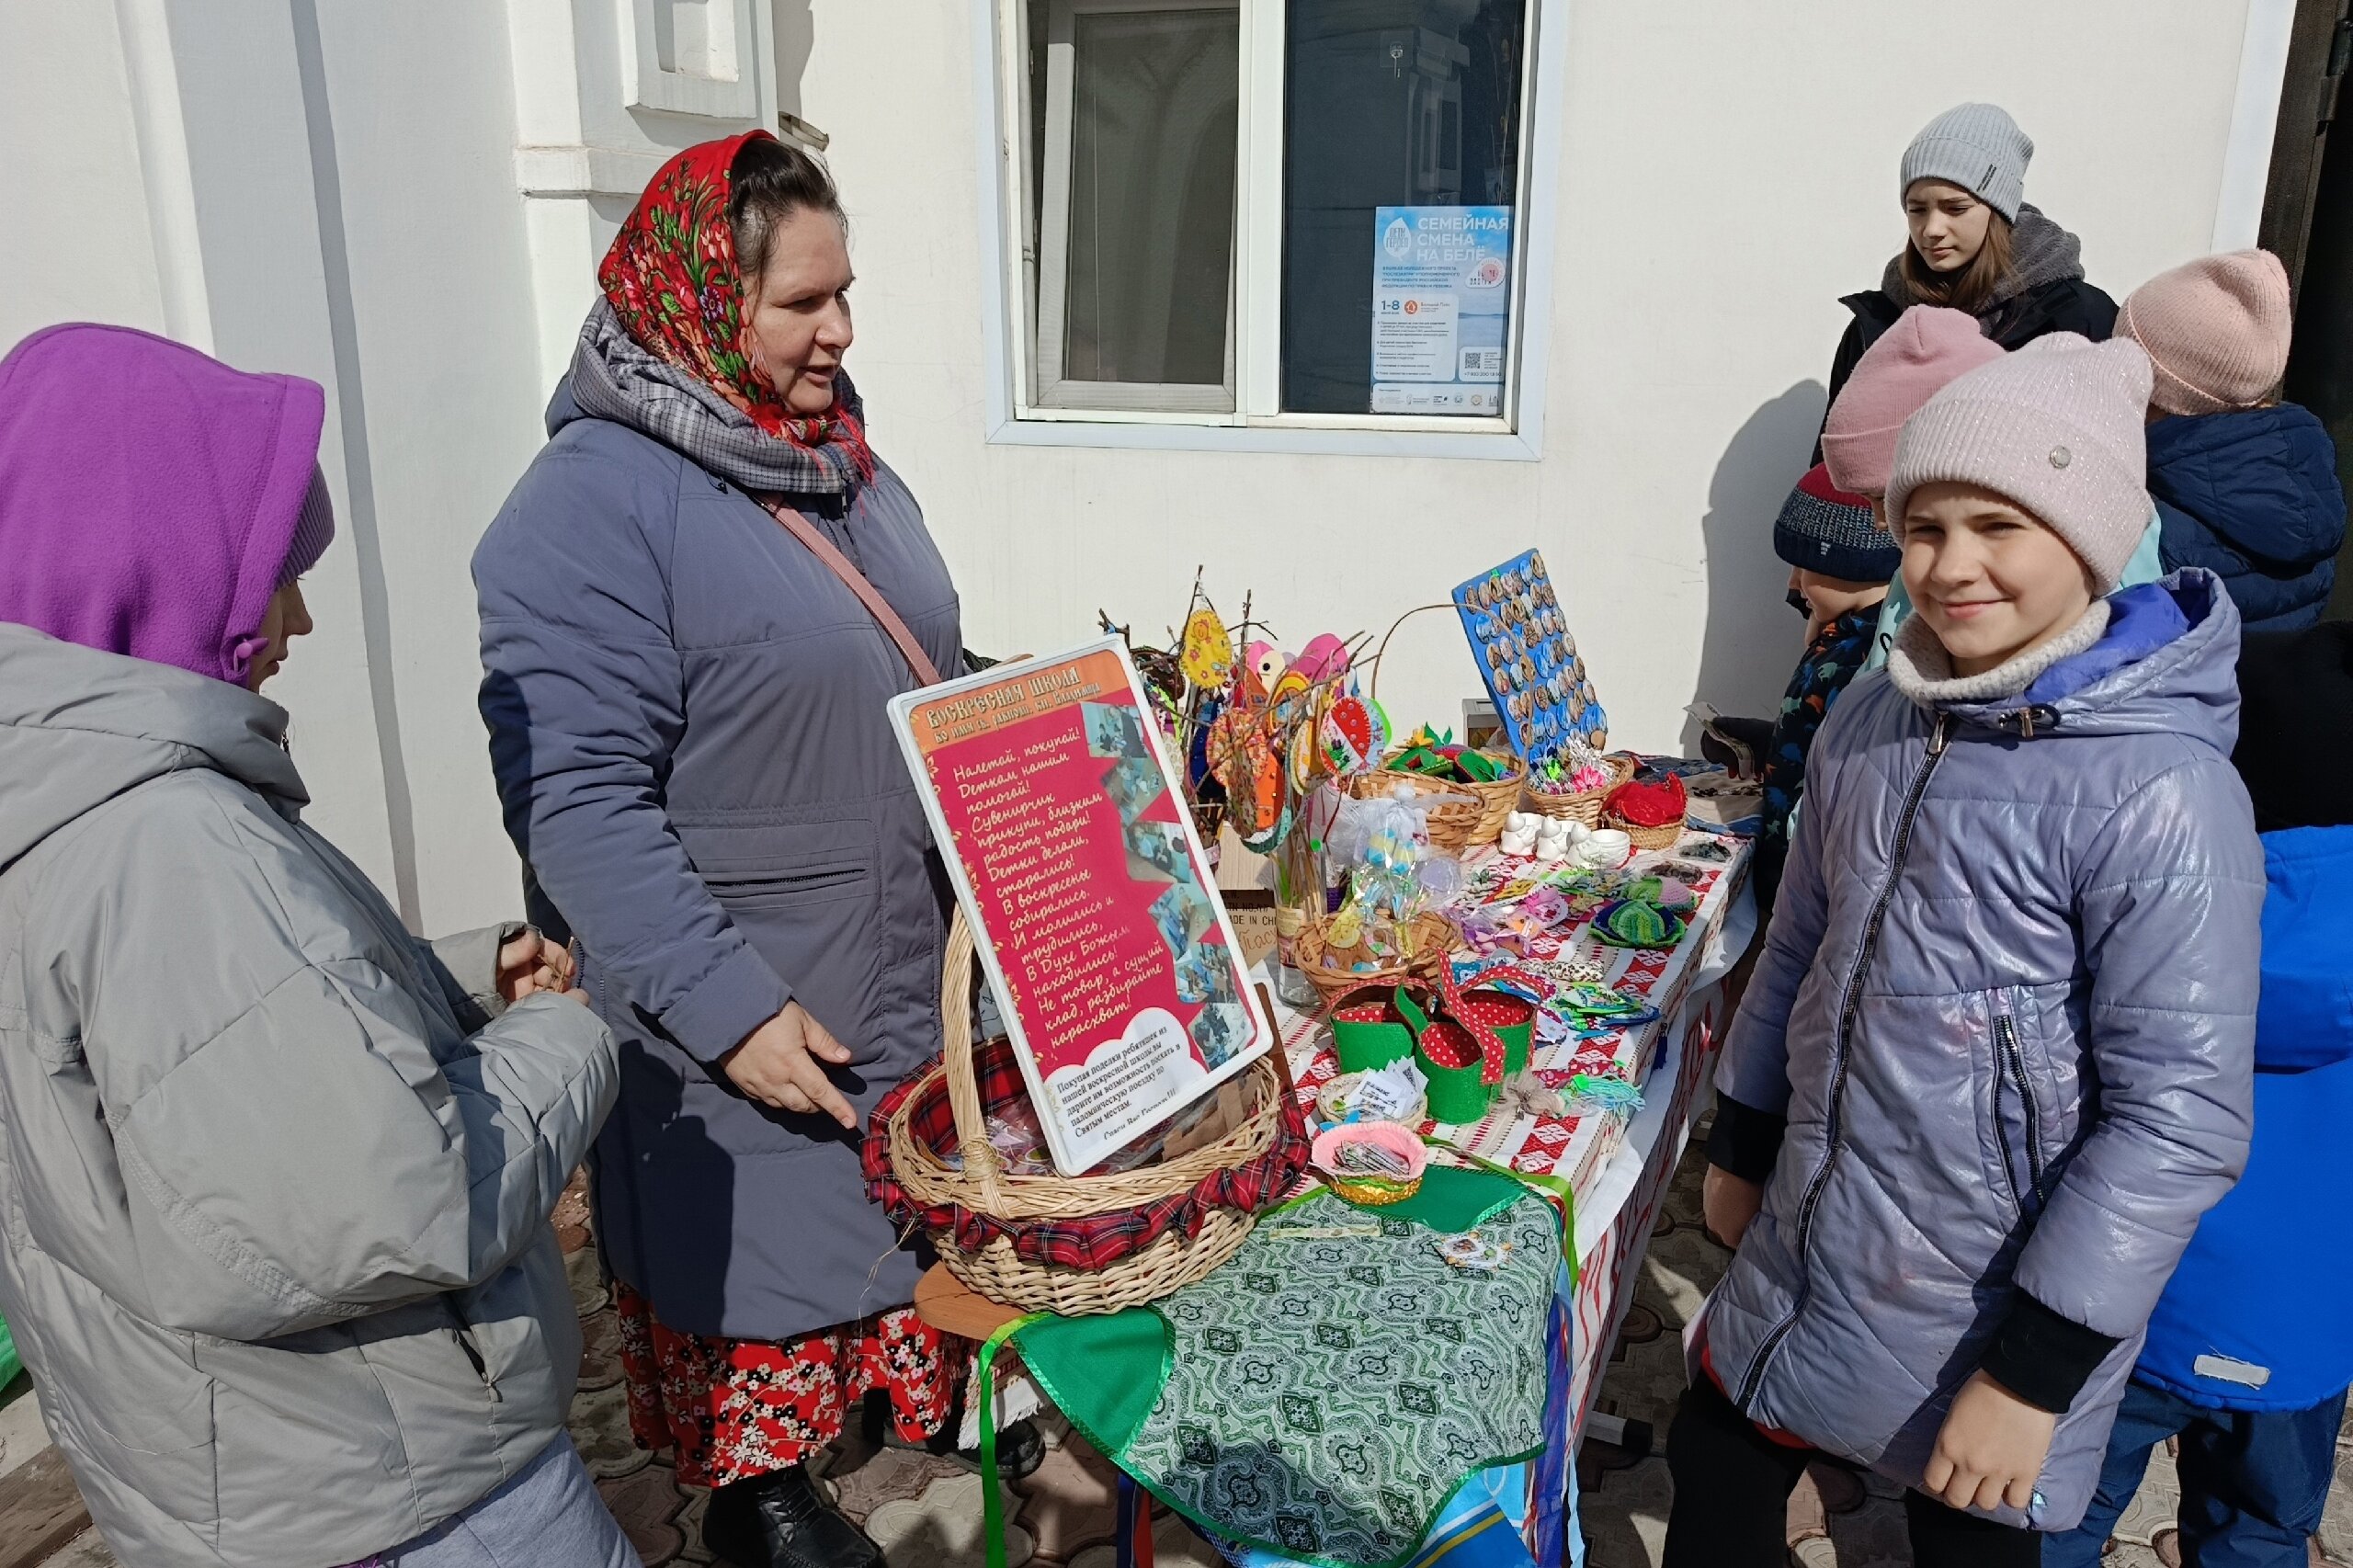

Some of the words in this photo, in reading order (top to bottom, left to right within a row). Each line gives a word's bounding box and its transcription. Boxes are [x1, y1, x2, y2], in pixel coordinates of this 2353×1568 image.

[1417, 233, 1474, 245] СМЕНА
[1418, 214, 1508, 230] СЕМЕЙНАЯ
[1416, 249, 1439, 261] НА
[1444, 245, 1485, 261] БЕЛЁ
[1381, 300, 1400, 310] 1-8
[926, 684, 1026, 729] ВОСКРЕСНАЯ
[1028, 666, 1082, 698] ШКОЛА
[953, 749, 1021, 782] Налетай,
[1024, 726, 1082, 758] покупай!
[958, 770, 1018, 799] Деткам
[1021, 752, 1070, 778] нашим
[966, 780, 1031, 815] помогай!
[972, 792, 1056, 833] Сувенирчик
[977, 815, 1046, 849] прикупи,
[1048, 792, 1103, 822] близким
[983, 835, 1041, 869] радость
[1045, 810, 1092, 840] подари!
[987, 856, 1039, 882] Детки
[1040, 835, 1089, 861] делали,
[995, 853, 1075, 899] старались!
[1002, 899, 1014, 915] В
[1017, 869, 1092, 909] воскресенье
[1009, 889, 1090, 931] собирались.
[1014, 931, 1027, 949] И
[1032, 901, 1103, 940] молились
[1106, 896, 1114, 905] и
[1229, 915, 1245, 925] ADE
[1250, 915, 1257, 925] IN
[1262, 915, 1277, 926] CHI
[1021, 921, 1103, 964] трудились,
[1026, 966, 1038, 982] В
[1040, 950, 1077, 974] Духе
[1032, 945, 1119, 998] находились!
[1038, 996, 1057, 1016] Не
[1061, 973, 1109, 1005] товар,
[1112, 967, 1121, 978] а
[1124, 939, 1165, 973] сущий
[1045, 1003, 1084, 1032] клад,
[1087, 962, 1164, 1010] разбирайте
[1051, 994, 1132, 1049] нарасхват!
[1057, 1071, 1090, 1094] Покупая
[1091, 1052, 1121, 1075] поделки
[1121, 1030, 1158, 1059] ребятишек
[1062, 1084, 1087, 1105] нашей
[1088, 1060, 1130, 1092] воскресной
[1067, 1096, 1092, 1117] дарите
[1093, 1090, 1104, 1101] им
[1105, 1063, 1150, 1096] возможность
[1070, 1088, 1128, 1127] паломническую
[1128, 1072, 1156, 1093] поездку
[1074, 1117, 1104, 1138] Святым
[1104, 1098, 1132, 1120] местам.
